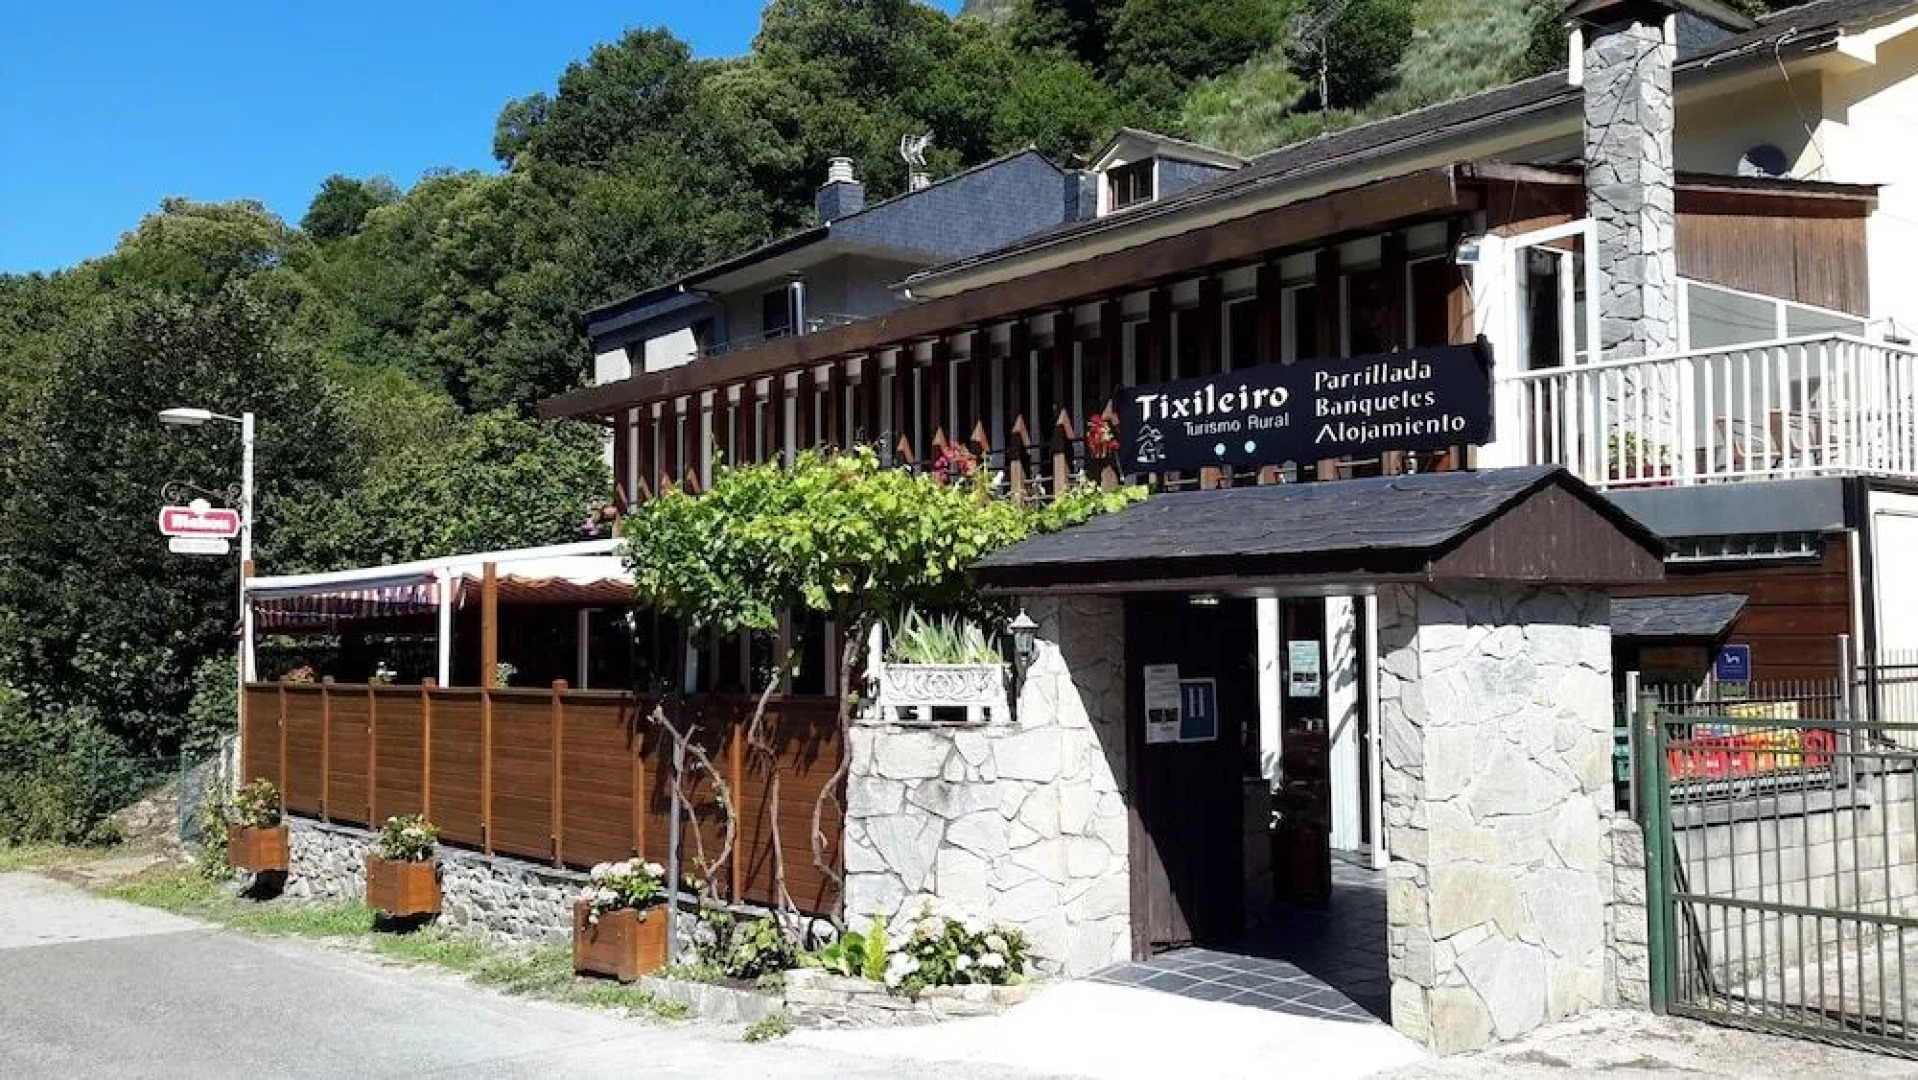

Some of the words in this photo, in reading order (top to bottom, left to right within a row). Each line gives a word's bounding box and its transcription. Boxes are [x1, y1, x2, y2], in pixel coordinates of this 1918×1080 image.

[1315, 359, 1432, 392] Parrillada
[1135, 383, 1289, 422] Tixileiro
[1315, 390, 1436, 417] Banquetes
[1183, 419, 1242, 436] Turismo
[1247, 412, 1290, 430] Rural
[1315, 413, 1466, 444] Alojamiento
